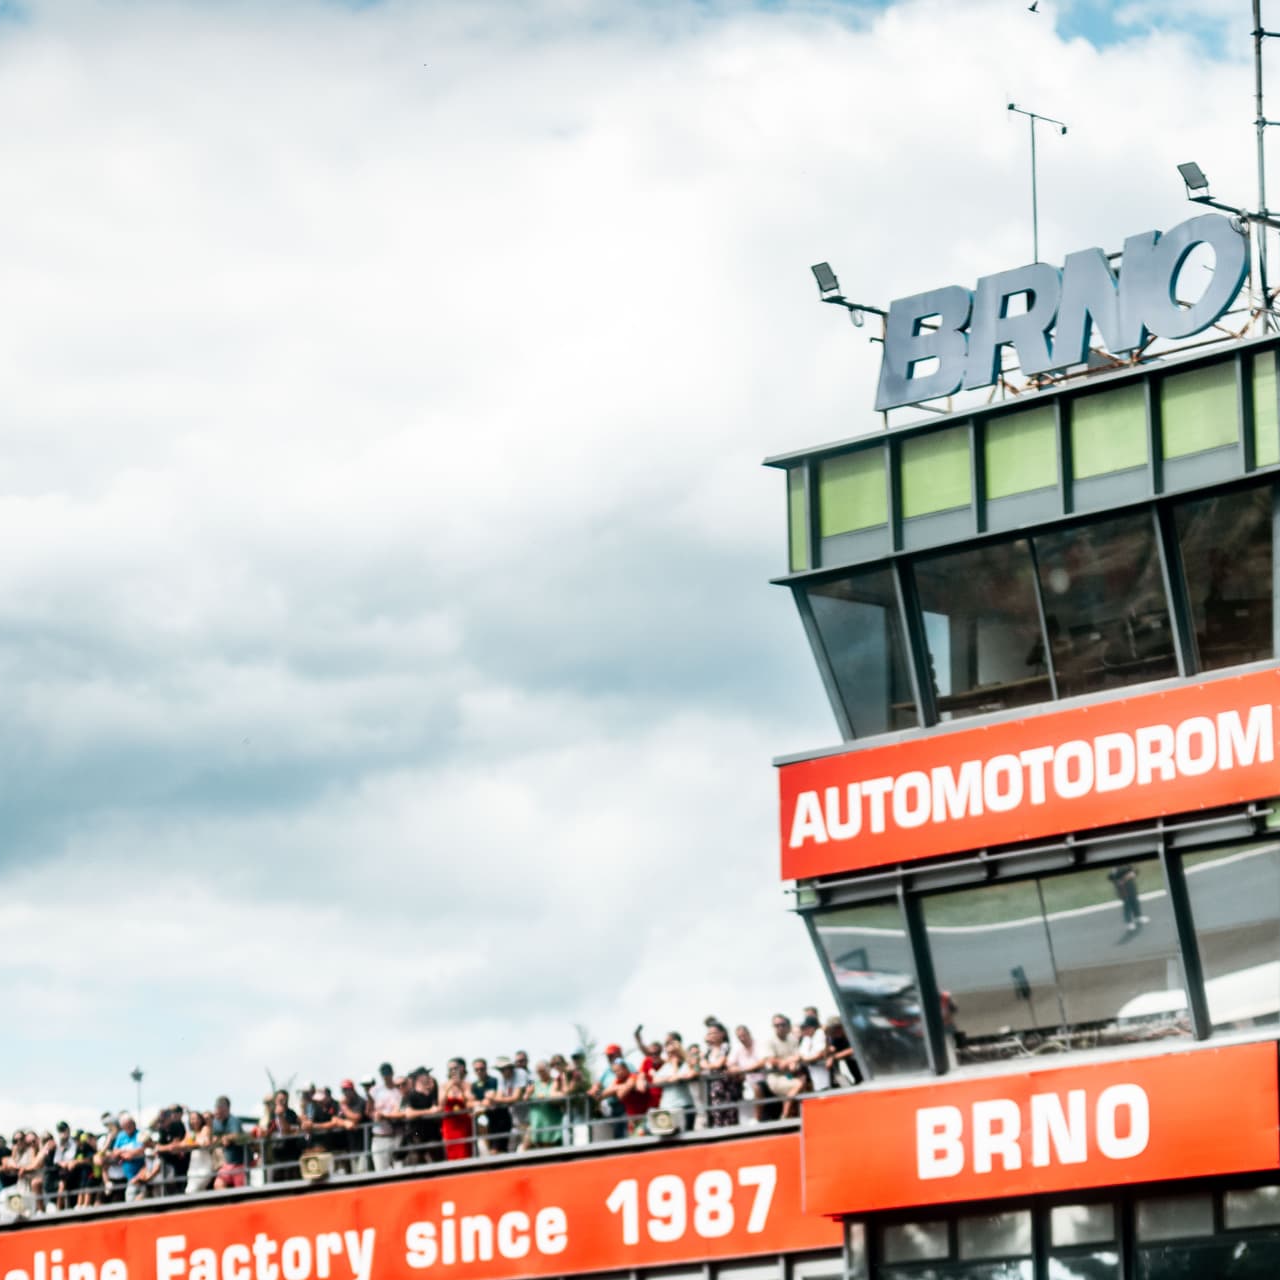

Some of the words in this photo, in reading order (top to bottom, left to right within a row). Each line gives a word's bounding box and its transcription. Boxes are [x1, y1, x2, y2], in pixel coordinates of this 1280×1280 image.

[874, 213, 1250, 411] BRNO
[788, 704, 1274, 849] AUTOMOTODROM
[917, 1083, 1151, 1181] BRNO
[405, 1201, 568, 1269] since
[606, 1164, 777, 1246] 1987
